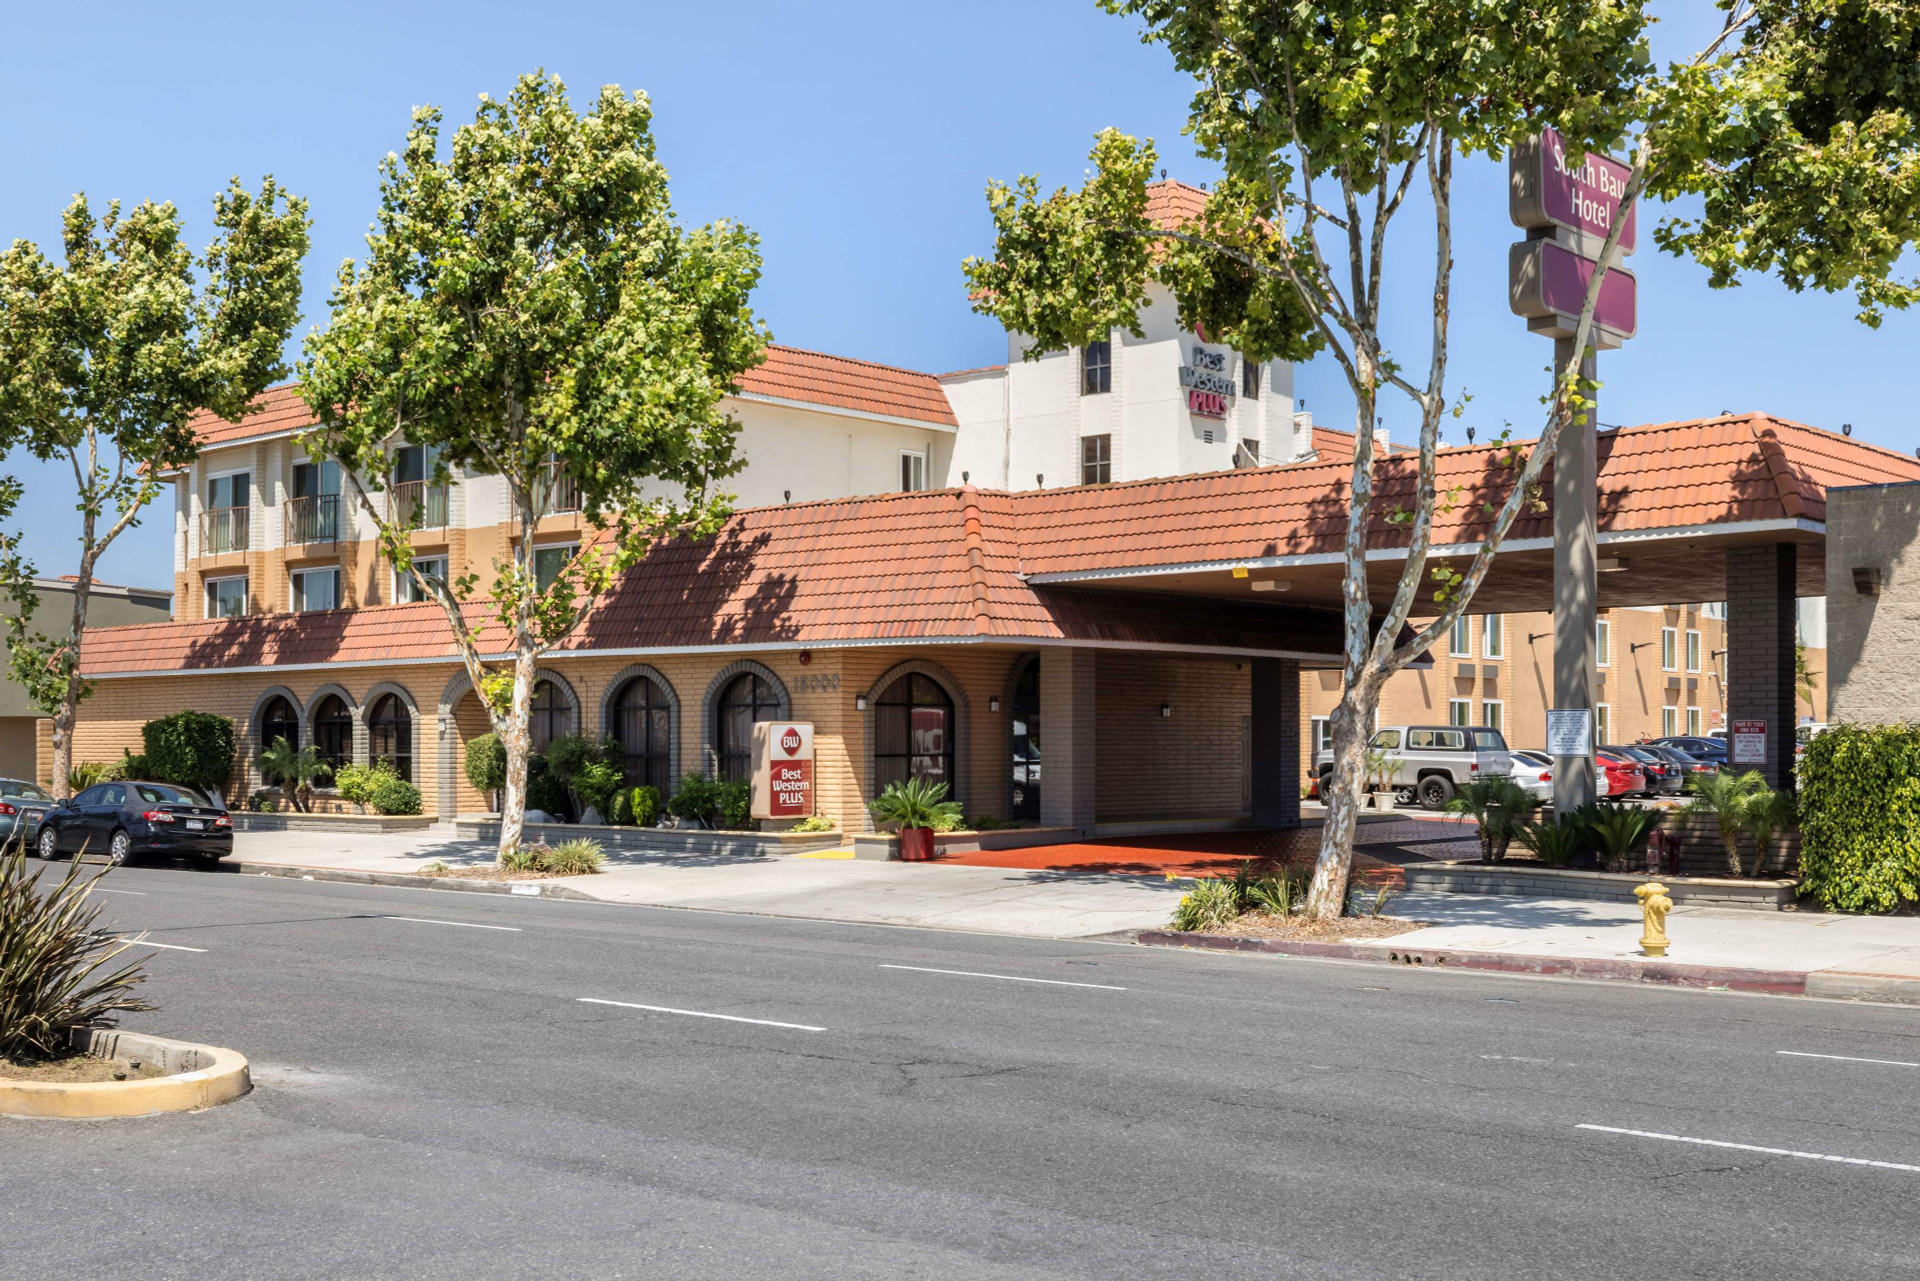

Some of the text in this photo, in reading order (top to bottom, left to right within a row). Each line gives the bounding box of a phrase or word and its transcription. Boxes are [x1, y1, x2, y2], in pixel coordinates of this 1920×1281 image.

[1571, 188, 1610, 229] Hotel
[1192, 347, 1225, 371] Best
[1179, 366, 1236, 397] Western
[1189, 390, 1227, 415] PLUS
[783, 736, 800, 748] BW
[781, 768, 802, 780] Best
[772, 780, 810, 792] Western
[779, 792, 804, 804] PLUS
